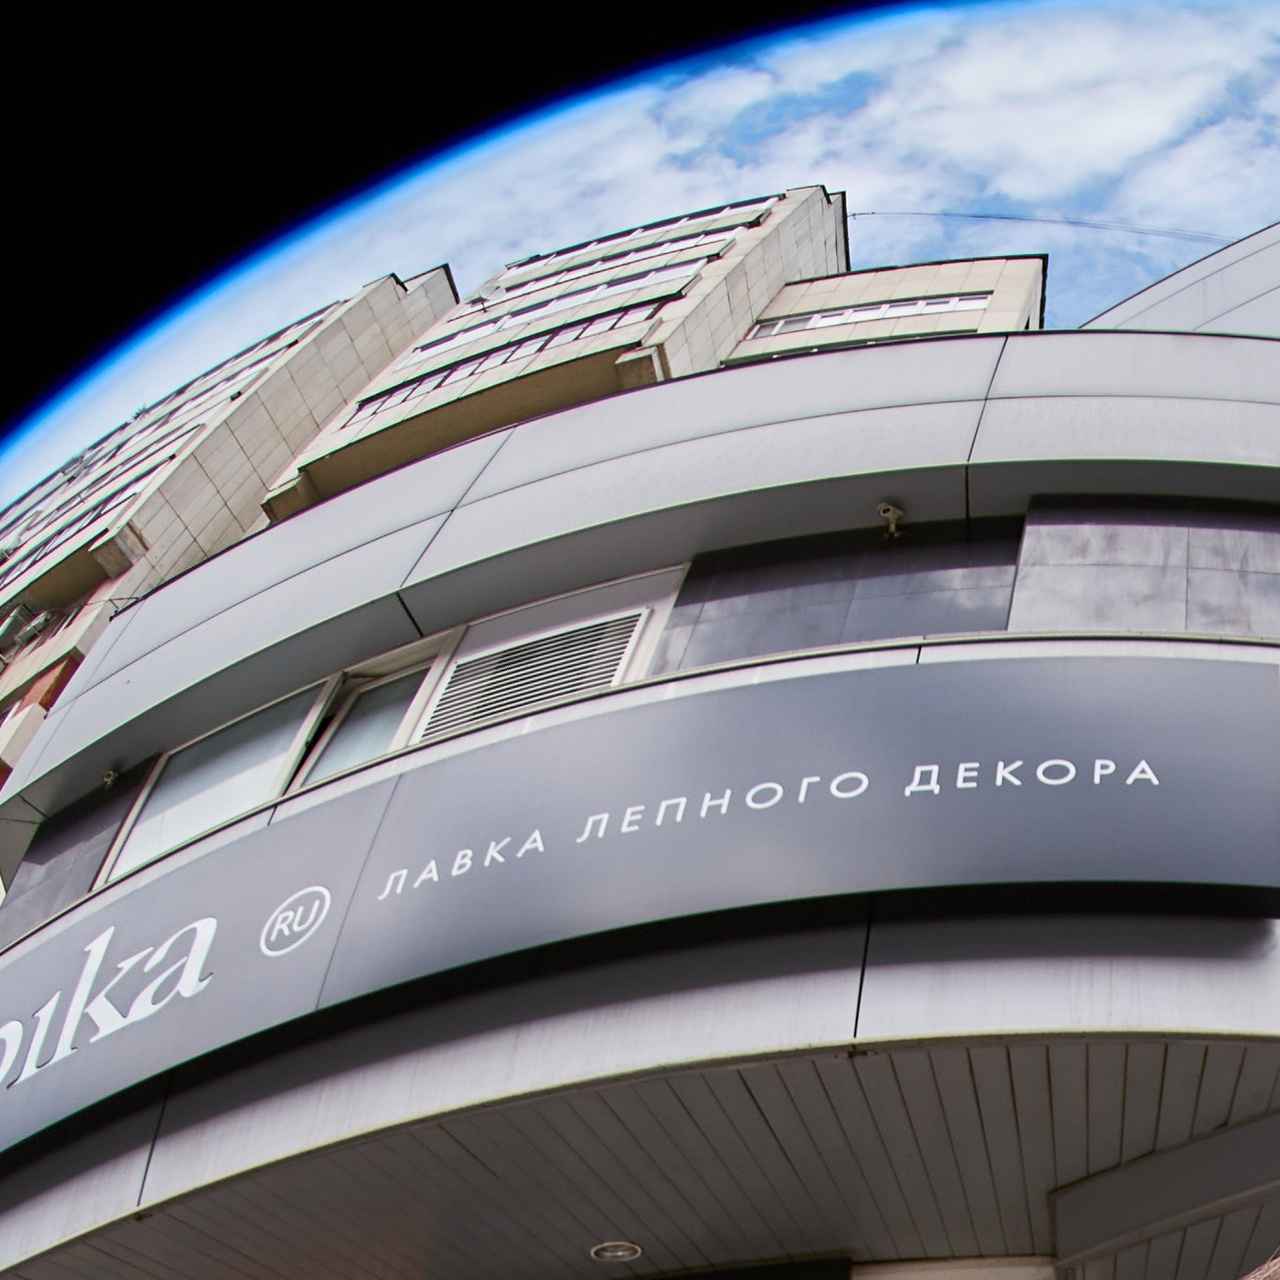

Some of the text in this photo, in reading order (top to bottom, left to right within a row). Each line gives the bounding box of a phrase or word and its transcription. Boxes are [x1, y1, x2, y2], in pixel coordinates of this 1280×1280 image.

[378, 757, 1160, 900] ЛАВКА ЛЕПНОГО ДЕКОРА
[269, 899, 320, 941] RU
